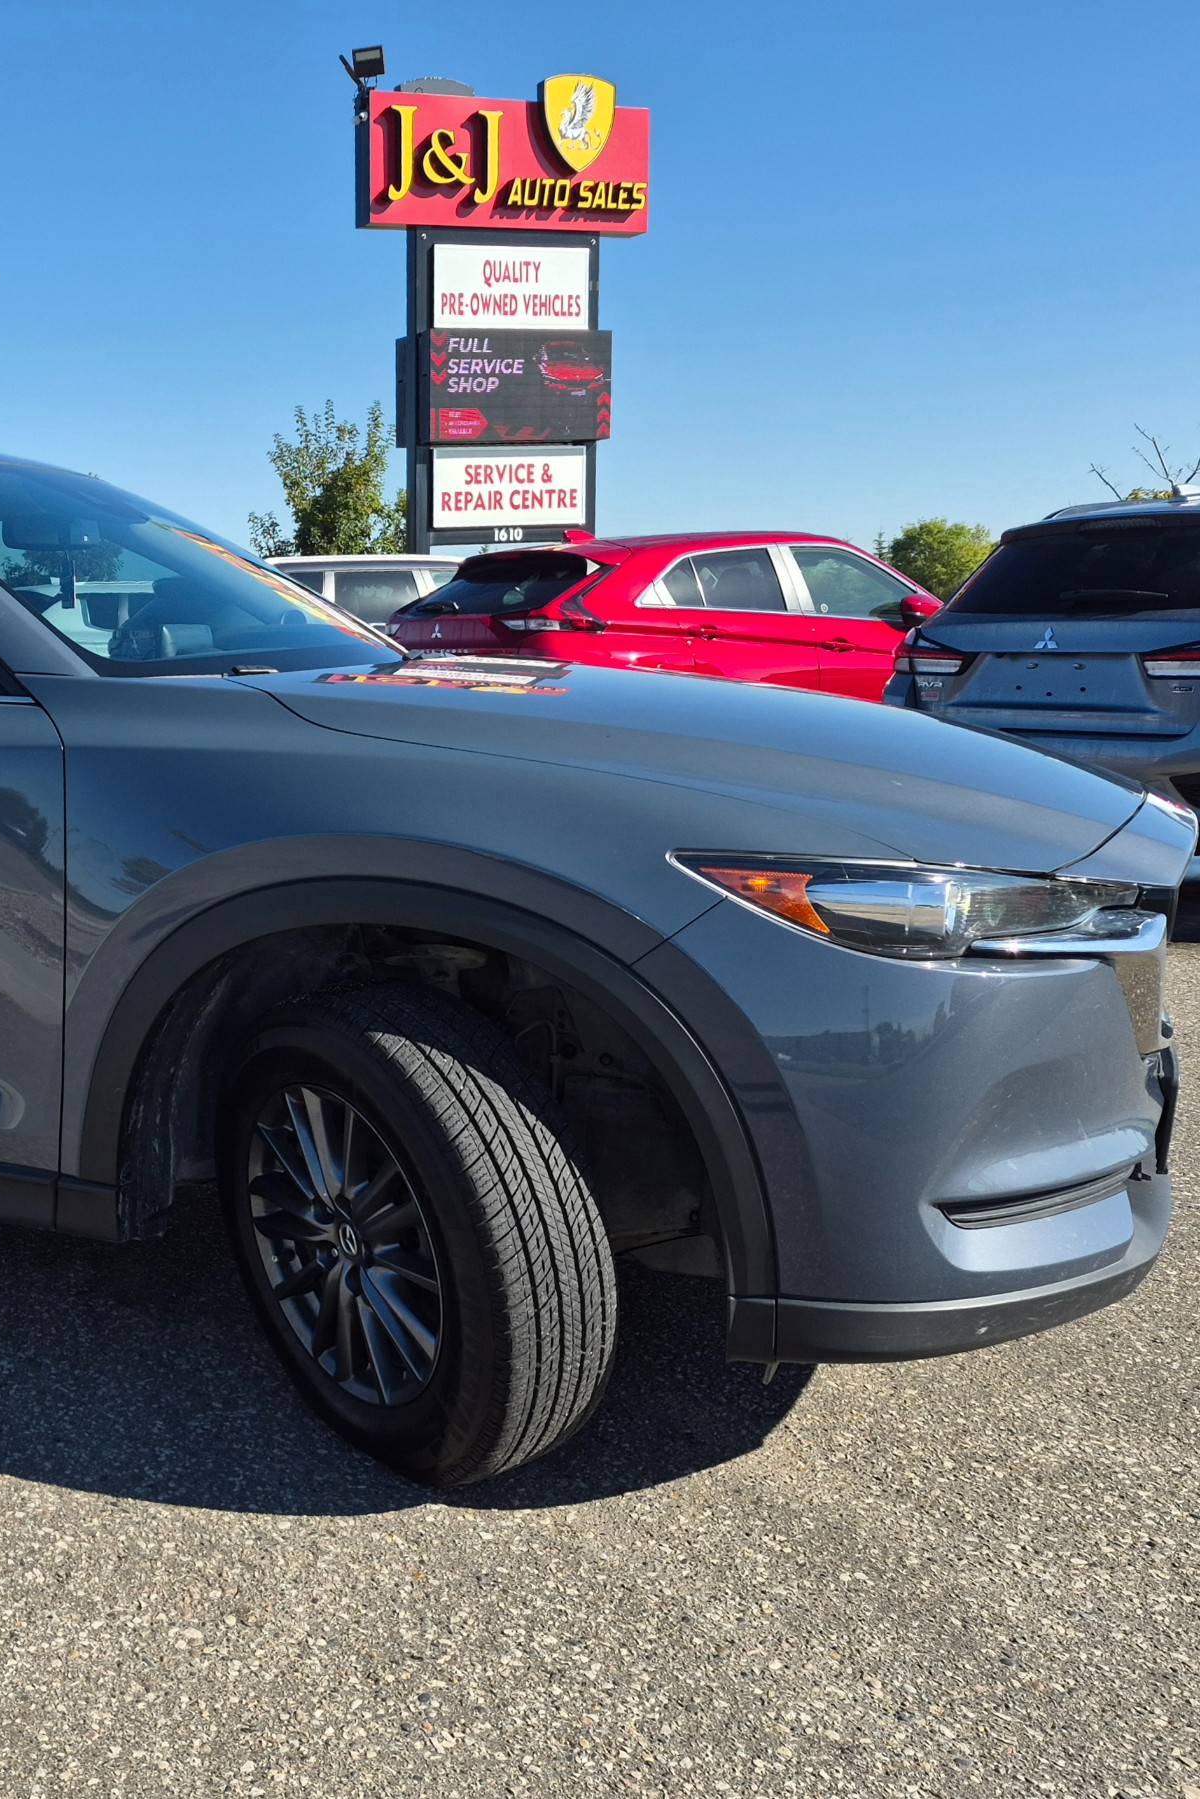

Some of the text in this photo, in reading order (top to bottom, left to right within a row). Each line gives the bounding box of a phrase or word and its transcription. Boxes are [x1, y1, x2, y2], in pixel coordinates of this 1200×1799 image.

[387, 104, 504, 204] J&J
[507, 177, 648, 210] AUTO SALES
[482, 259, 542, 288] QUALITY
[441, 292, 581, 317] PRE-OWNED VEHICLES
[448, 337, 493, 353] FULL
[447, 358, 524, 375] SERVICE
[447, 376, 500, 393] SHOP
[464, 463, 553, 485] SERVICE &
[441, 488, 578, 511] REPAIR CENTRE
[493, 527, 523, 541] 1610
